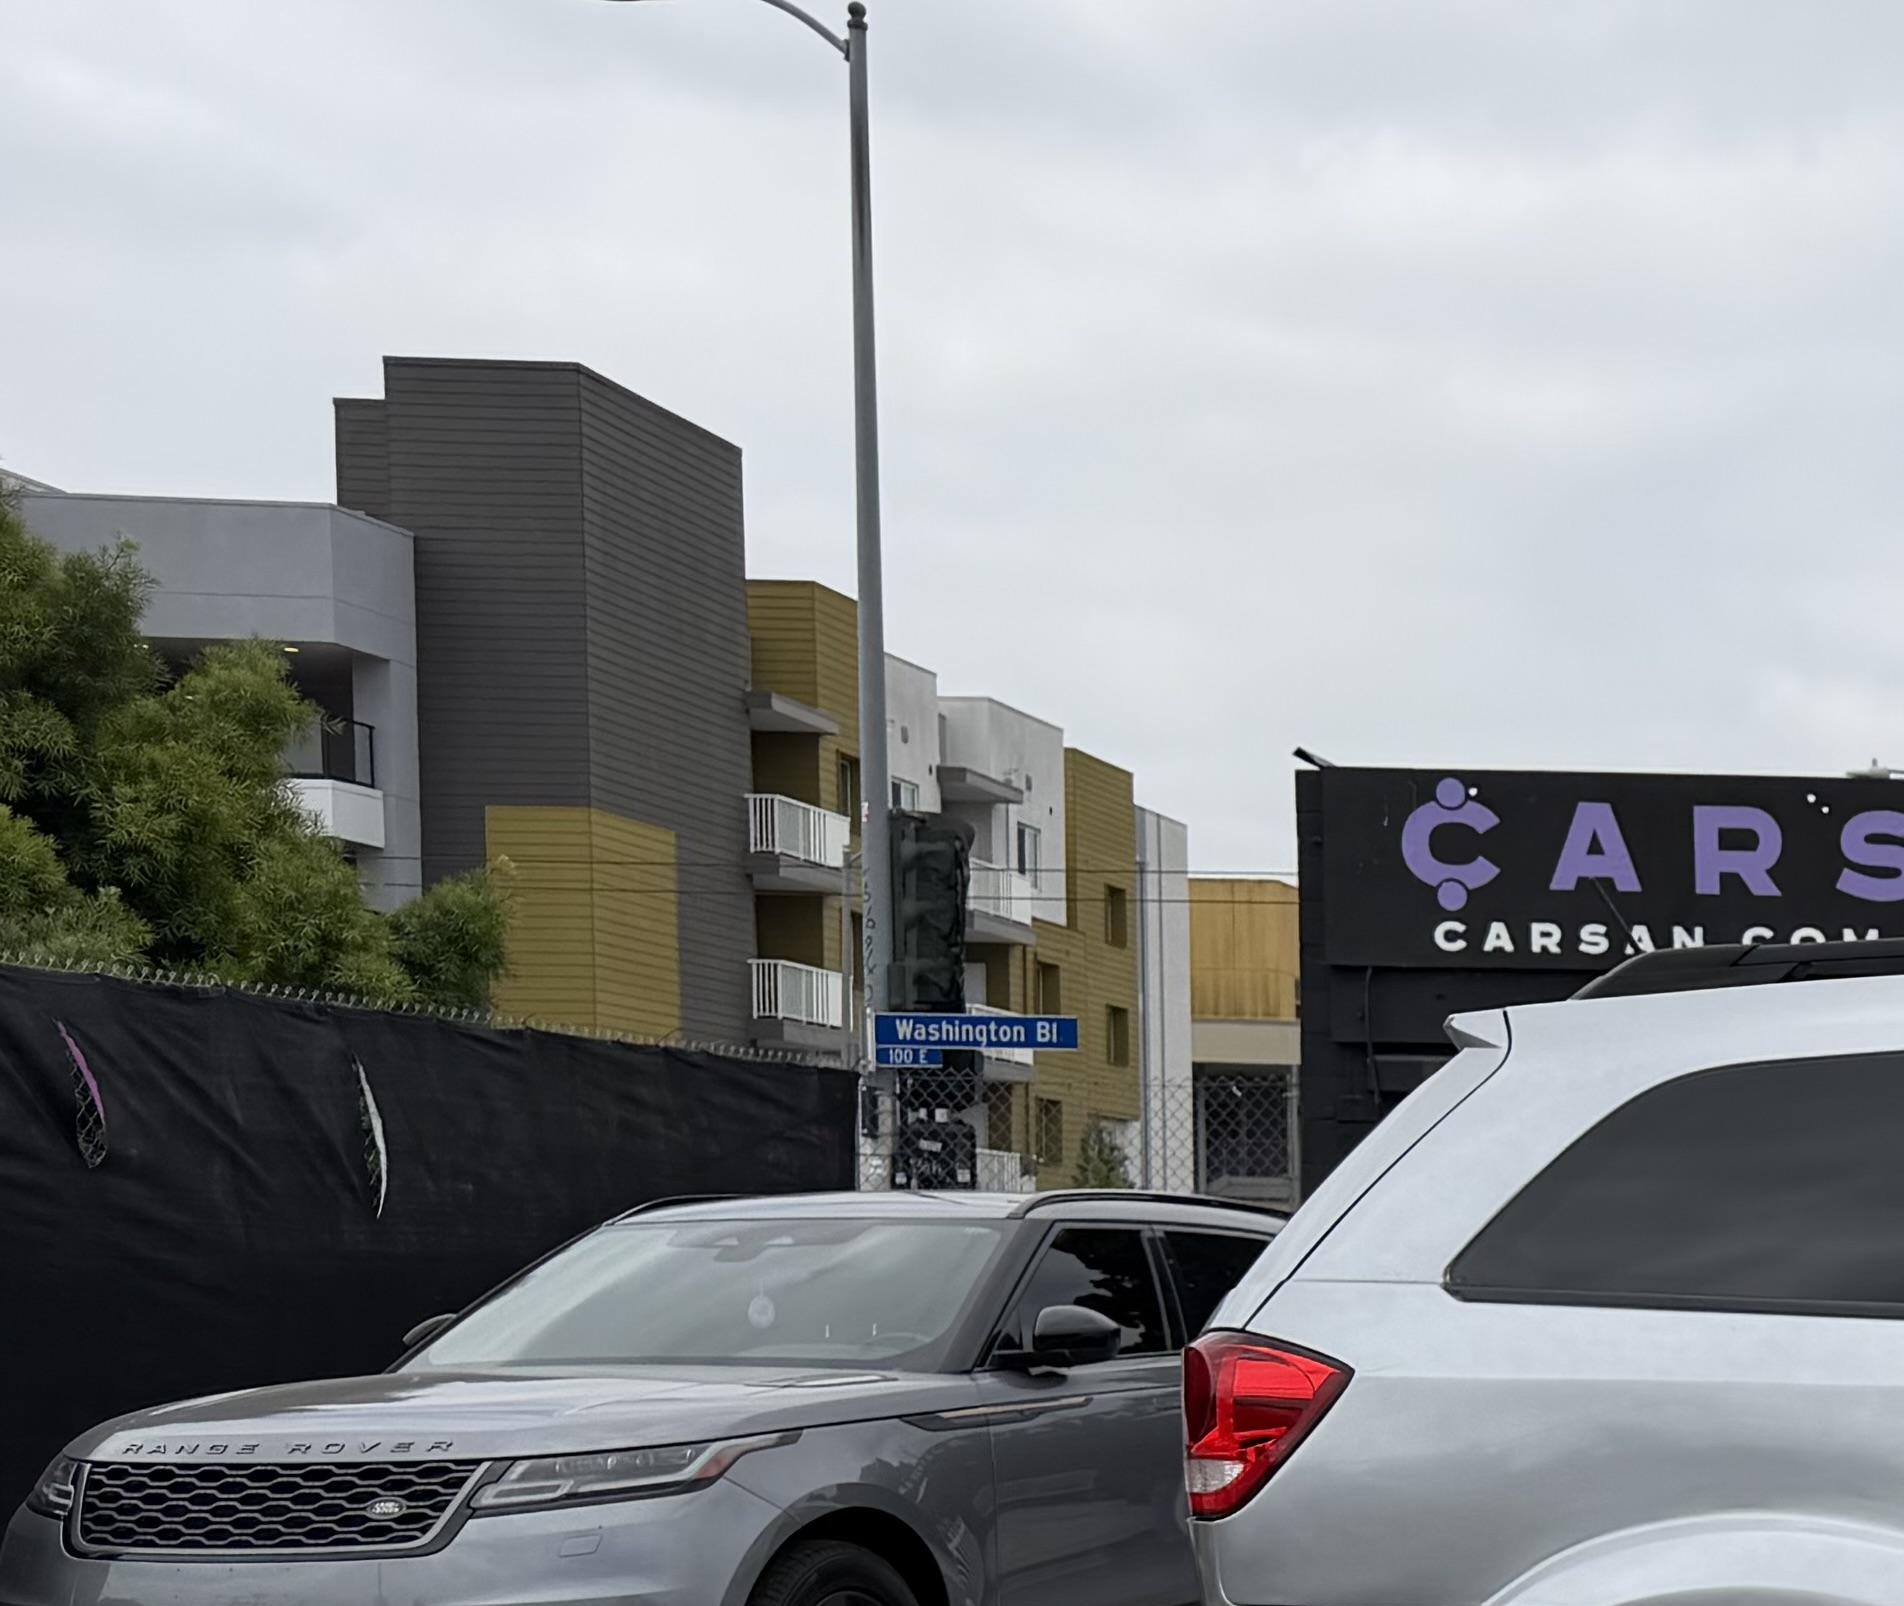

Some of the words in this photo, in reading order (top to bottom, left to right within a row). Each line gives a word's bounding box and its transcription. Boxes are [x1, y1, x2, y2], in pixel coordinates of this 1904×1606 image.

[894, 1018, 1025, 1047] Washington
[888, 1049, 913, 1064] 100
[919, 1049, 928, 1064] E
[122, 1443, 260, 1455] RANGE
[288, 1441, 453, 1454] ROVER
